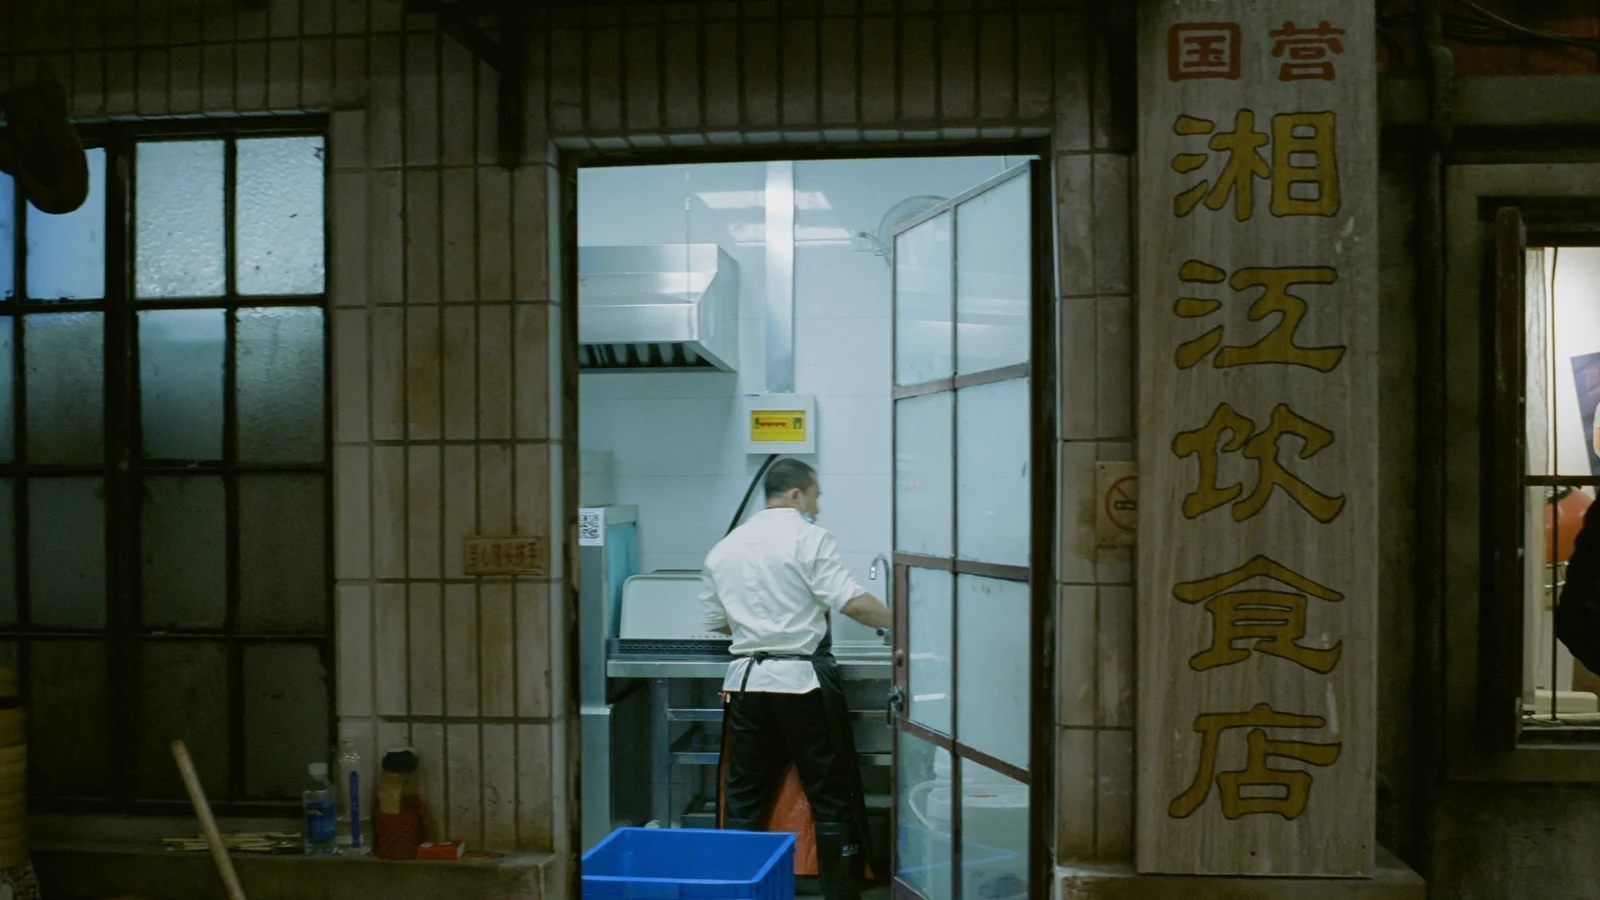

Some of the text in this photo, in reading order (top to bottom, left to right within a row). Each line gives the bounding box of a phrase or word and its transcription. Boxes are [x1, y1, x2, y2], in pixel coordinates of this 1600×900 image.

[1167, 21, 1346, 82] 国营
[1169, 108, 1348, 821] 湘江饮食店
